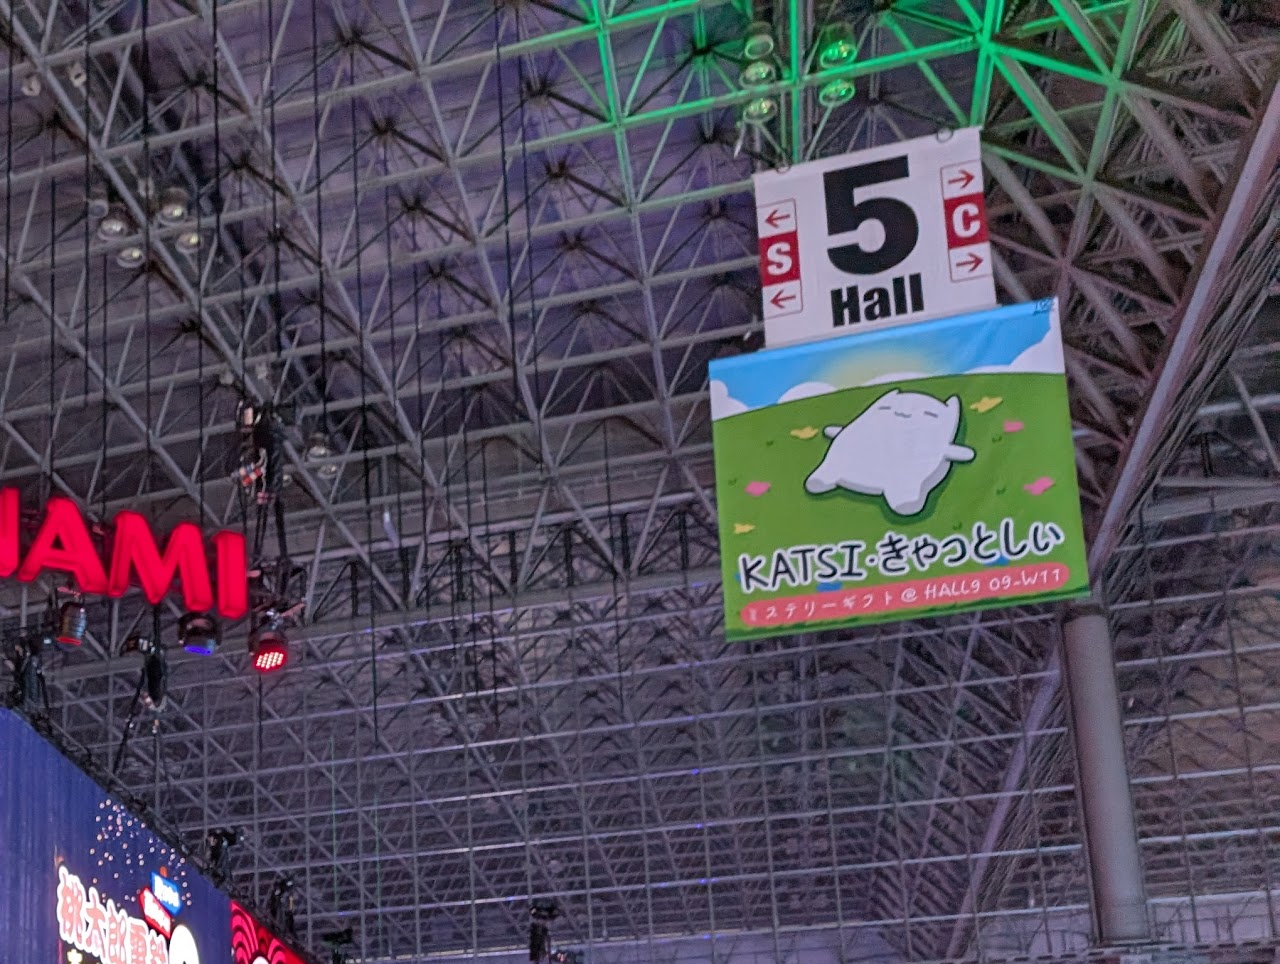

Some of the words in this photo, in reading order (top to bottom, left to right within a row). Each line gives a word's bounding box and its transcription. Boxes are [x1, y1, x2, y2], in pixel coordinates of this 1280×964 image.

[823, 155, 919, 275] 5
[951, 203, 981, 238] C
[766, 241, 793, 276] S
[830, 272, 924, 327] Hall
[924, 576, 980, 600] HALL9
